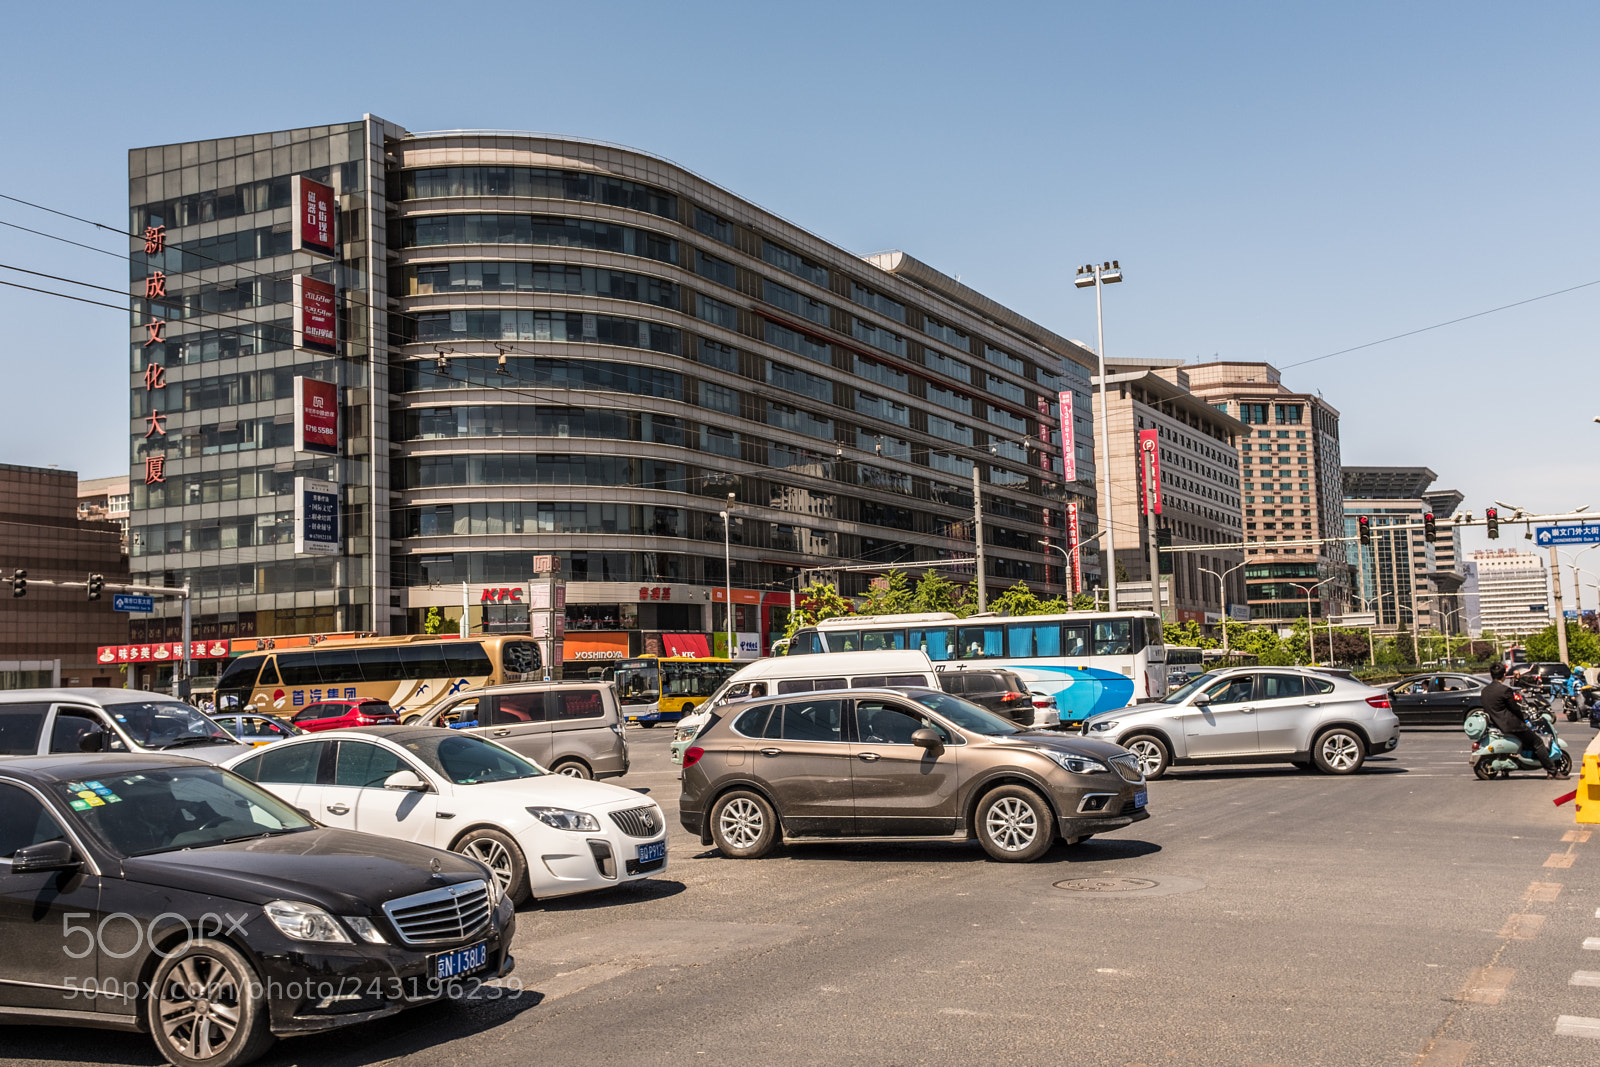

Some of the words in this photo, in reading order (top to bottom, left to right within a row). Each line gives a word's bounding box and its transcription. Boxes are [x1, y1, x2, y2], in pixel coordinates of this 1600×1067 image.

[144, 225, 166, 484] 新成文化大厦
[1552, 527, 1599, 536] 崇文门外大街
[481, 588, 522, 601] KFC
[639, 587, 671, 600] 肯德基
[118, 647, 150, 660] 味多美
[174, 643, 206, 657] 味美
[292, 687, 357, 706] 首汽集团
